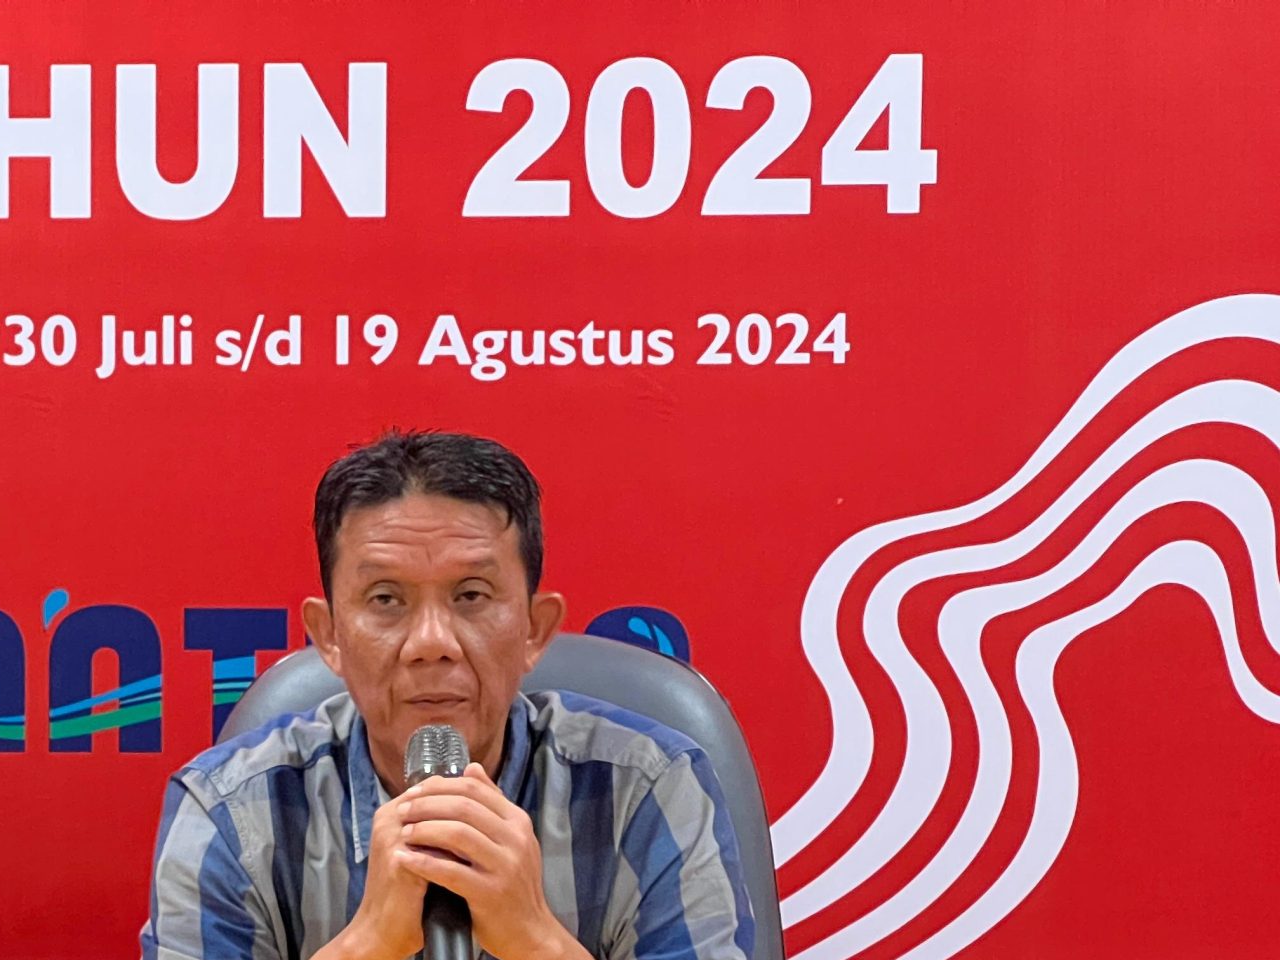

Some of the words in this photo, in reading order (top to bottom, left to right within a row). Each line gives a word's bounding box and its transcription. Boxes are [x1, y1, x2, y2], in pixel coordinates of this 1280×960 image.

[461, 53, 939, 219] 2024
[3, 314, 78, 367] 30
[95, 314, 194, 379] Juli
[215, 314, 303, 373] s/d
[334, 314, 400, 367] 19
[418, 314, 676, 382] Agustus
[696, 312, 852, 367] 2024
